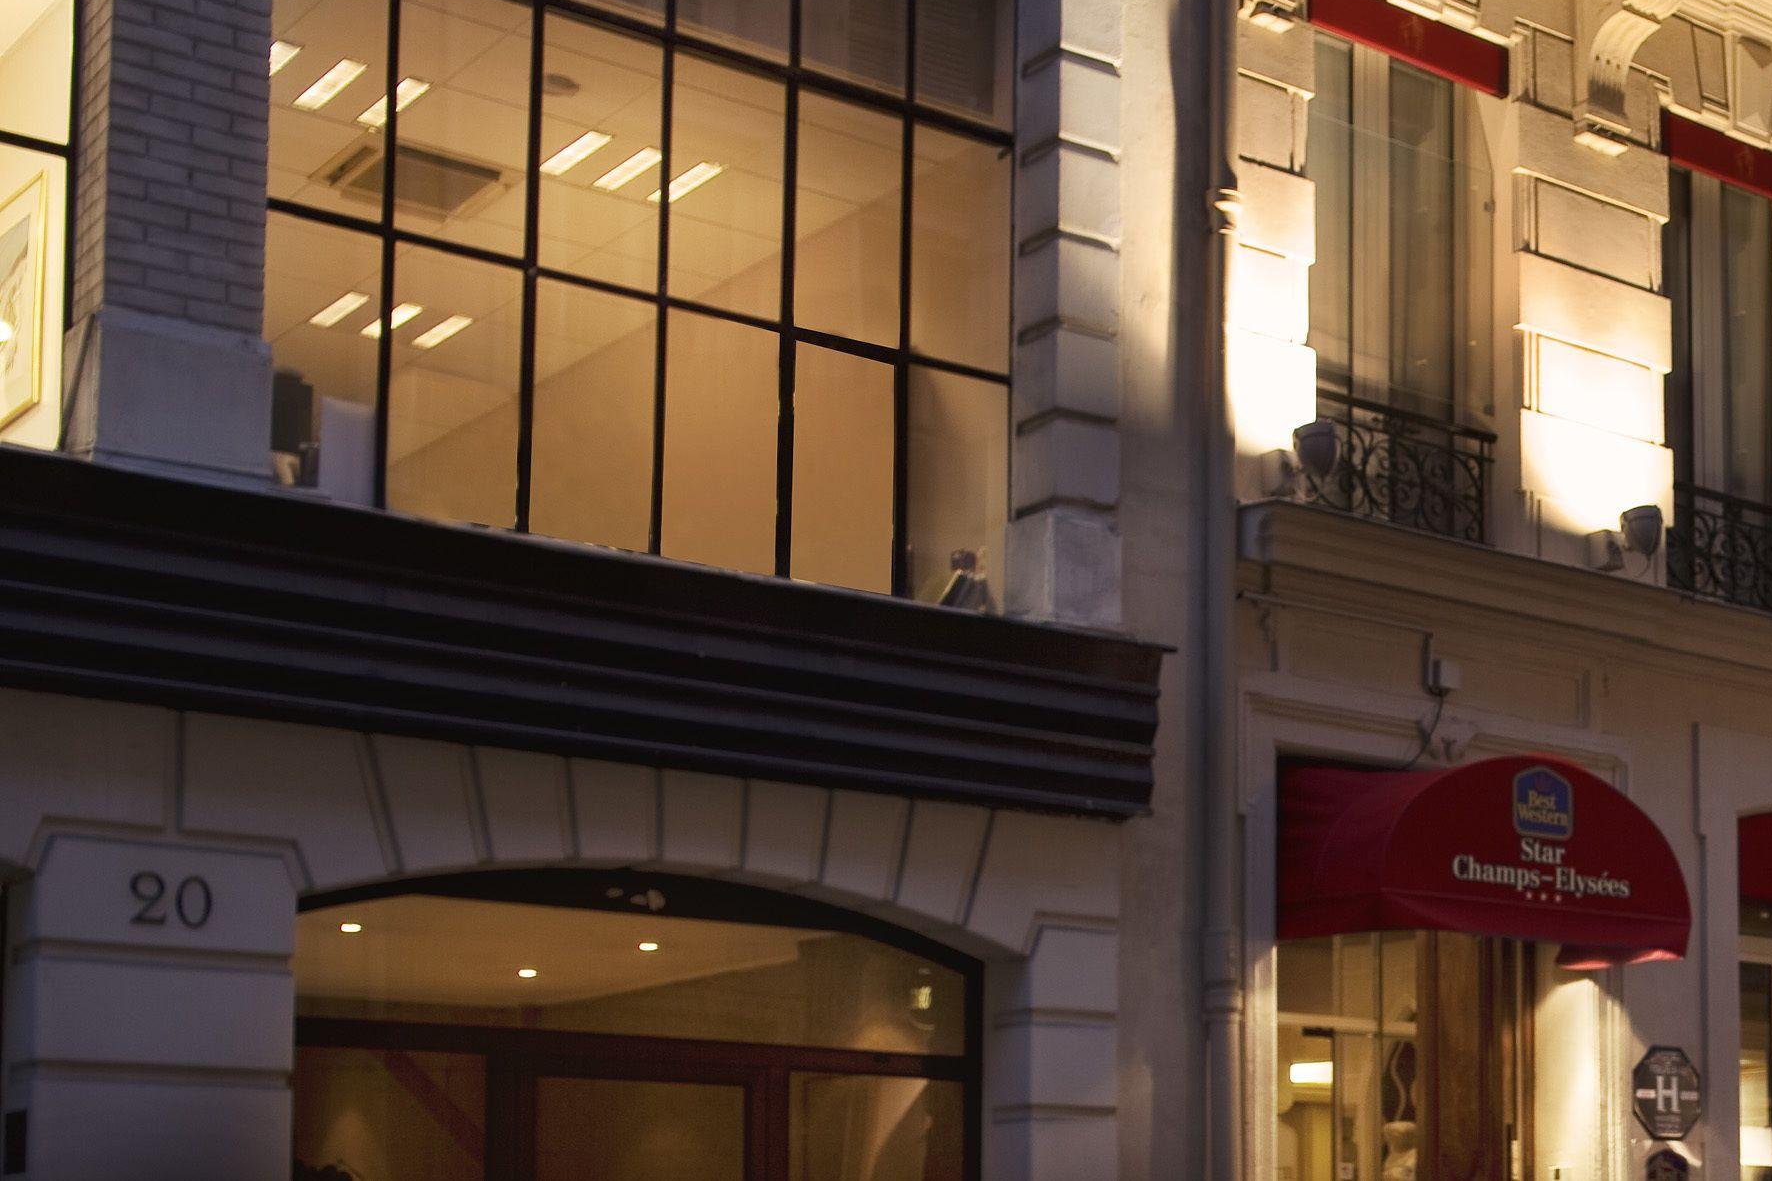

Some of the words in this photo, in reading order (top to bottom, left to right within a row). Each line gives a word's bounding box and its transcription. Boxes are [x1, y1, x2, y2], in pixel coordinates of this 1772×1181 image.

[1517, 803, 1570, 827] Western
[1528, 790, 1556, 808] Best
[1520, 837, 1566, 865] Star
[1452, 855, 1630, 898] Champs-Elysées
[129, 870, 213, 929] 20
[1656, 1075, 1681, 1113] H
